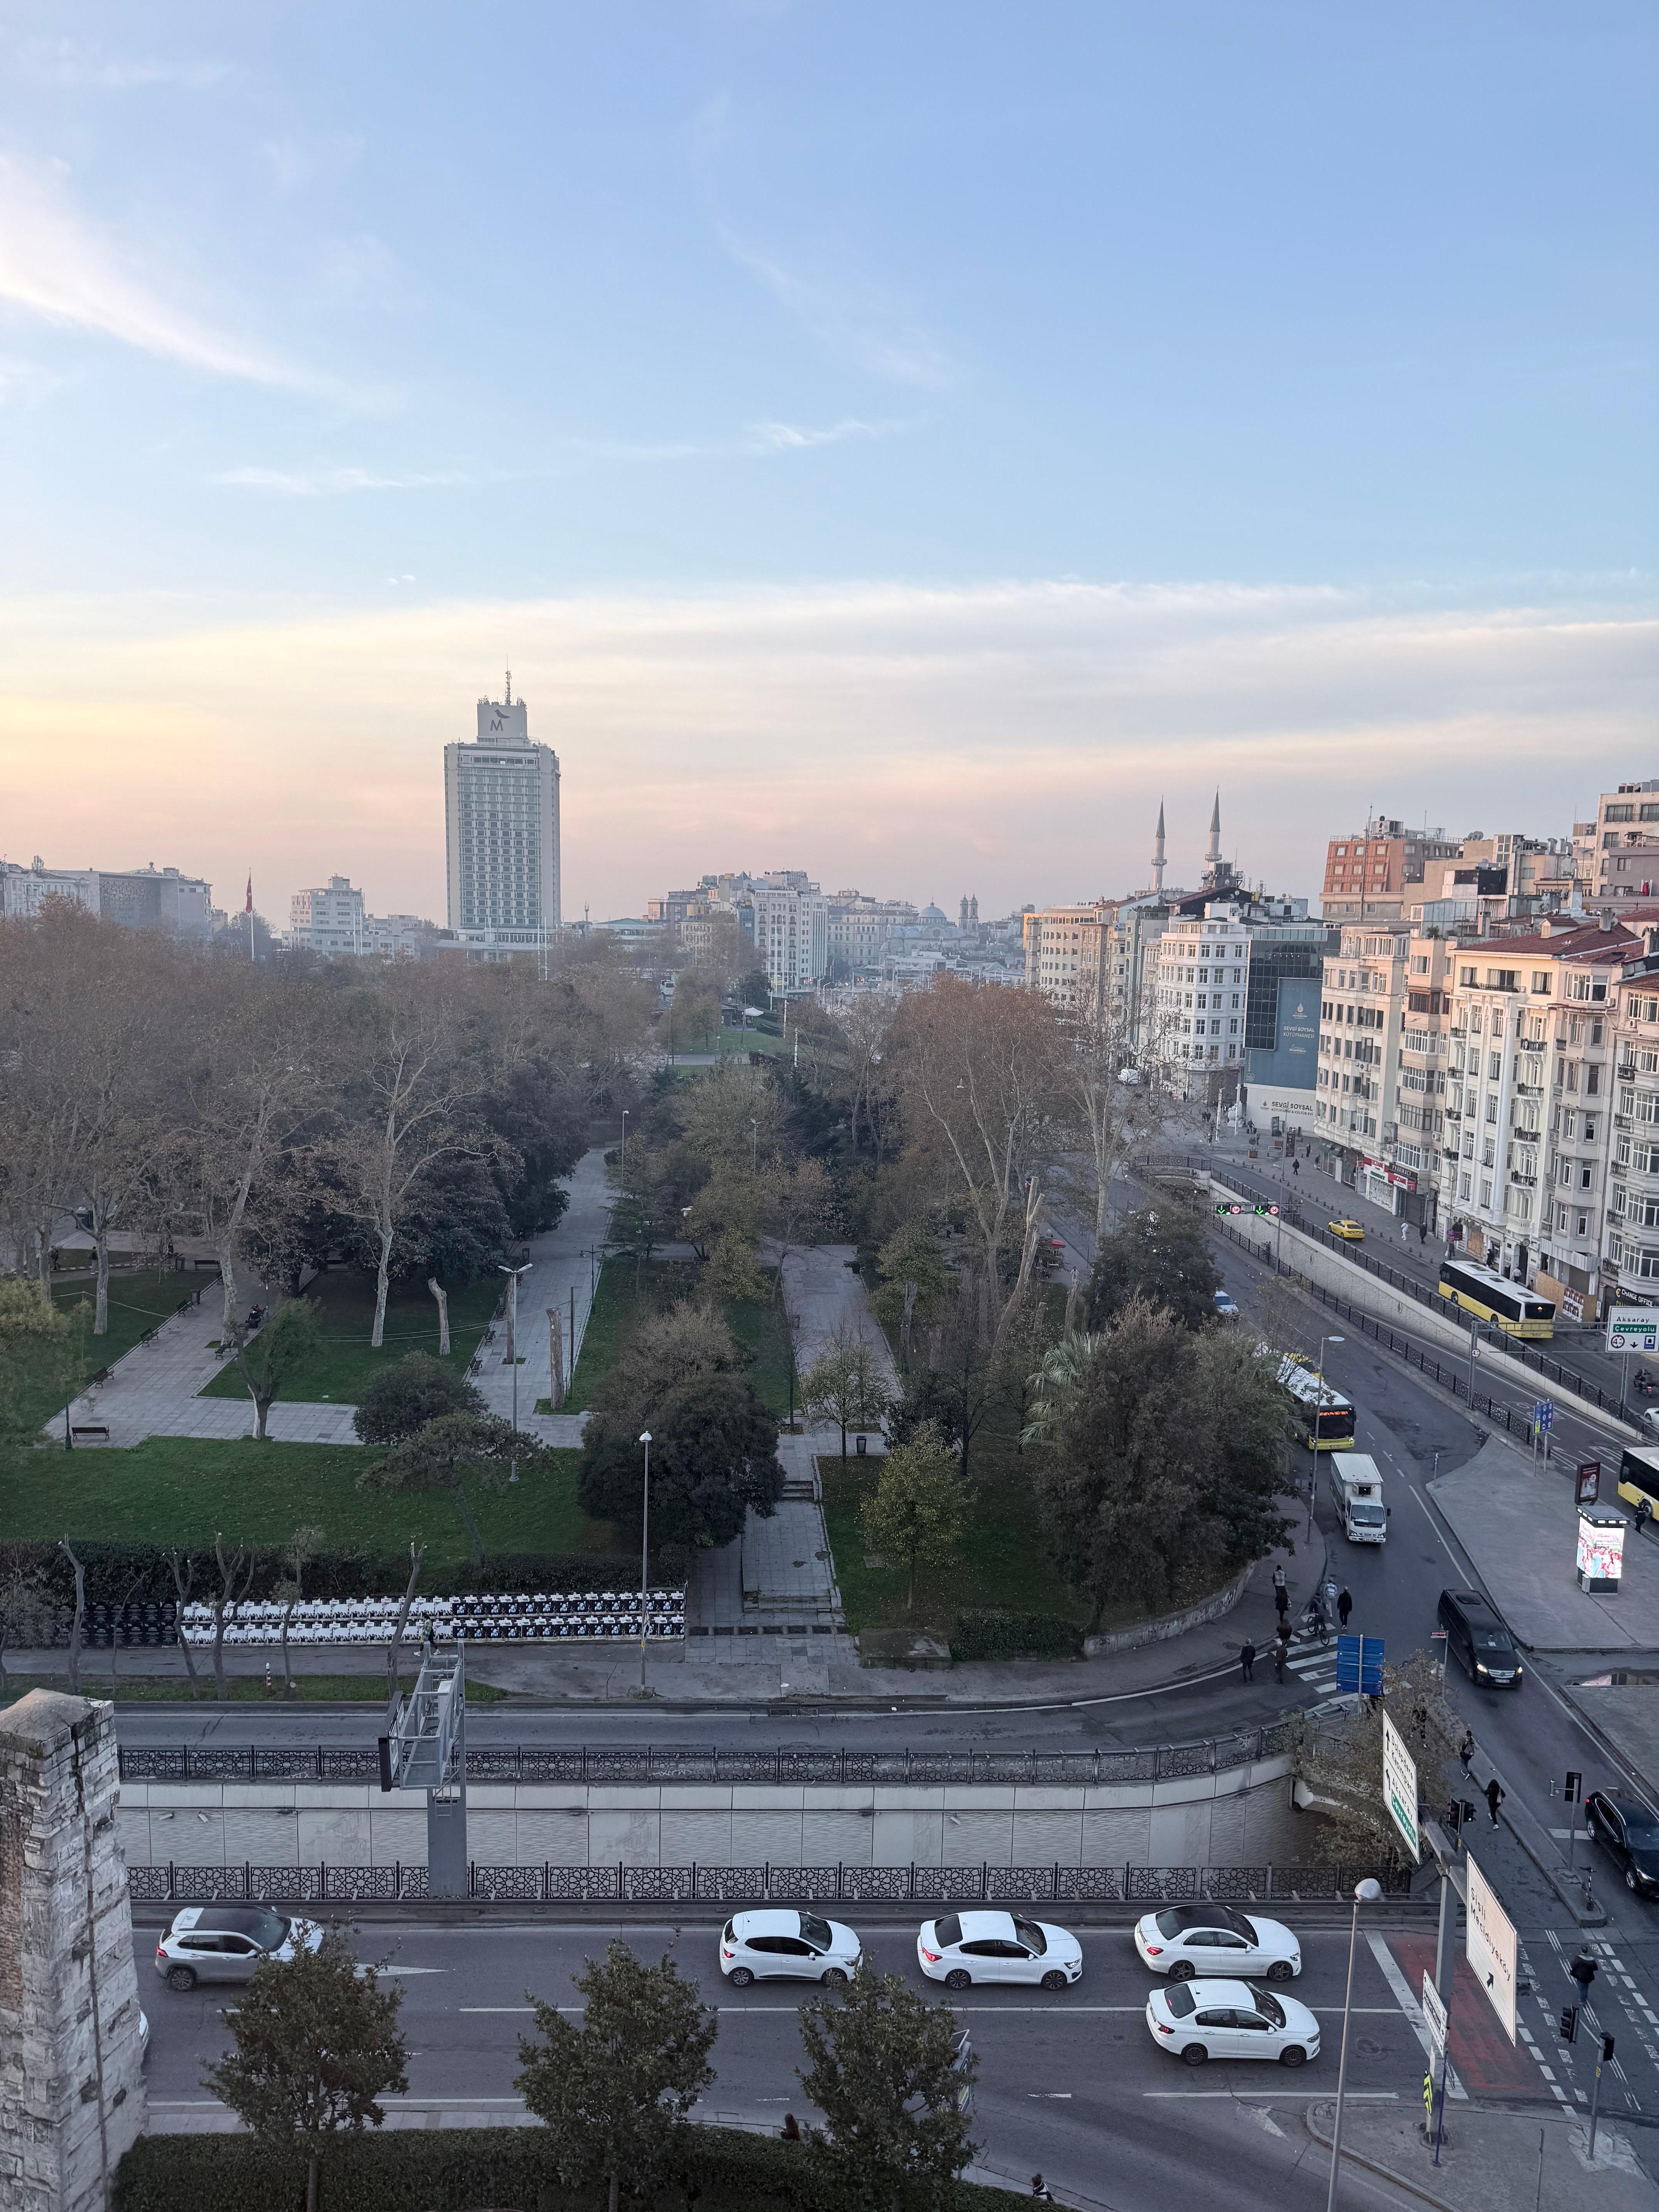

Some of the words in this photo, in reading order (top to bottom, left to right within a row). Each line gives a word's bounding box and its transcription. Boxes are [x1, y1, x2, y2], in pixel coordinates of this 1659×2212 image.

[1621, 1289, 1637, 1300] CHANGE
[1638, 1296, 1653, 1307] OFFICE
[1392, 1778, 1413, 1820] Aksaray
[1392, 1793, 1416, 1843] Çevreyolu
[1471, 1903, 1511, 1982] Mecidiyeköy
